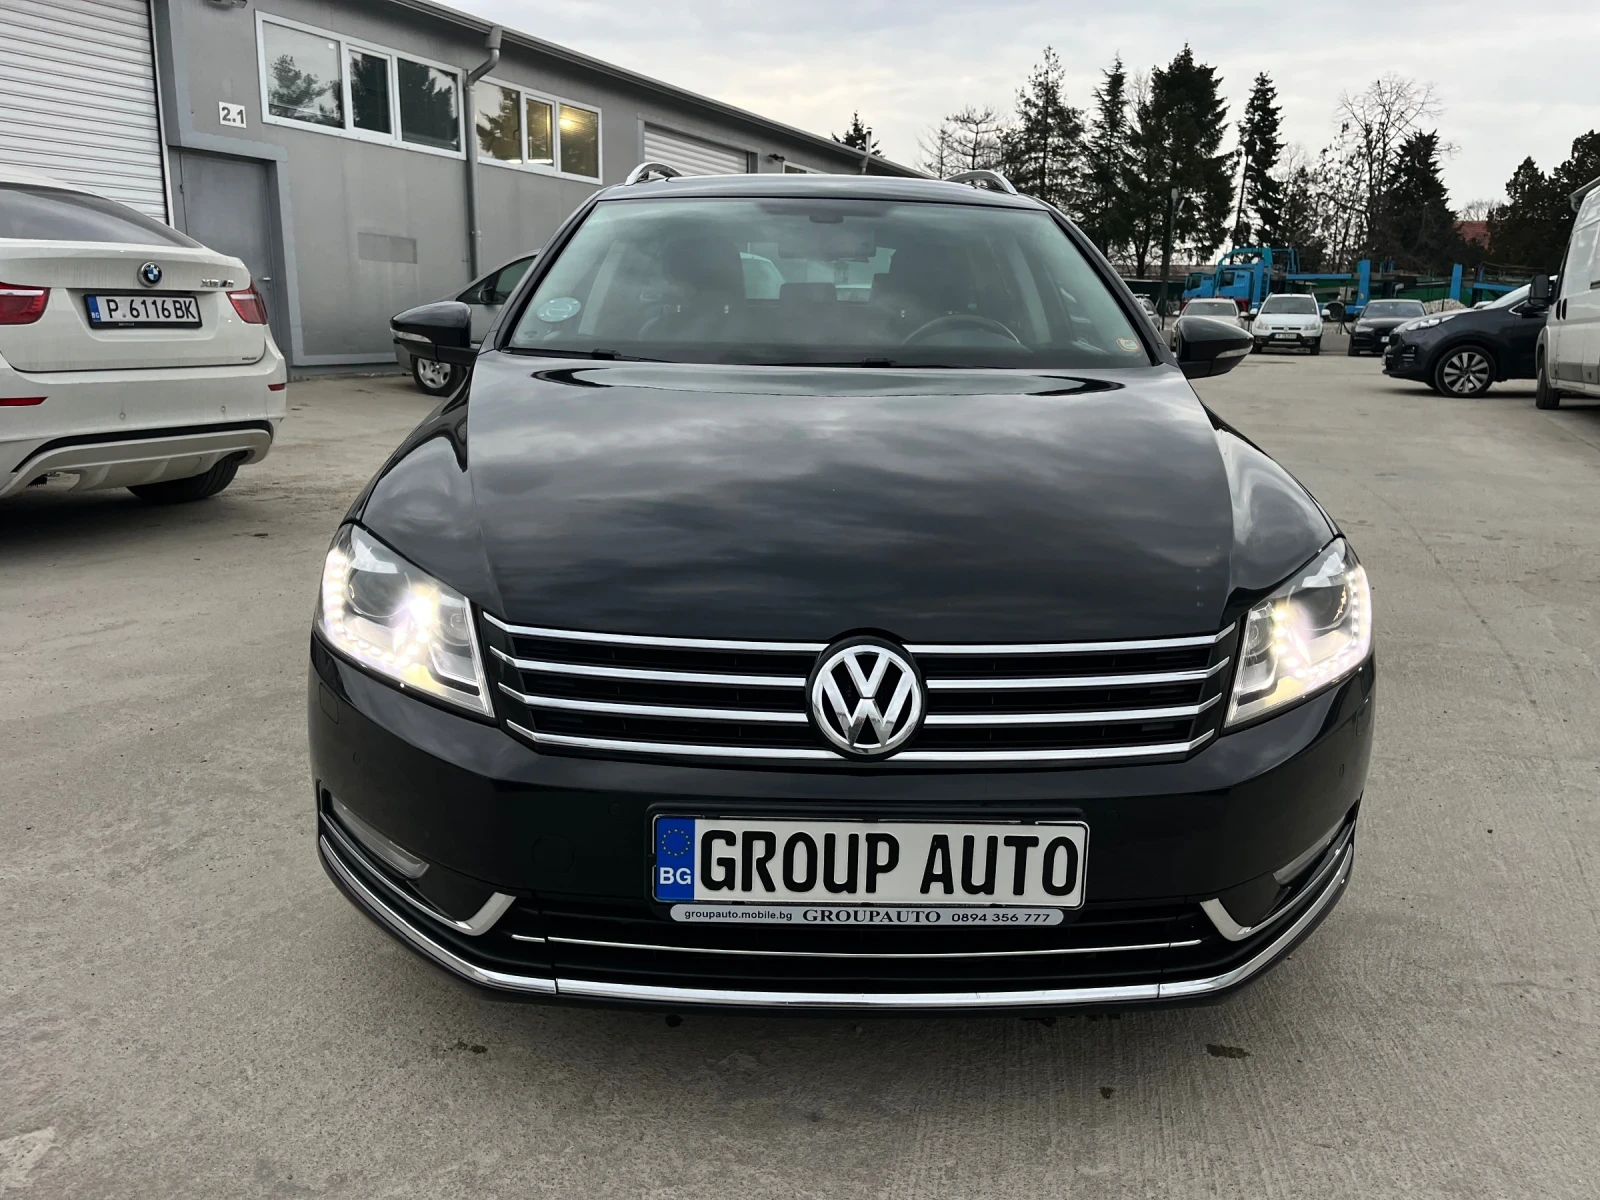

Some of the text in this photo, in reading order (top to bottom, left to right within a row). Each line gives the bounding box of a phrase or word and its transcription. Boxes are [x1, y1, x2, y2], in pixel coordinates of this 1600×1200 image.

[221, 106, 245, 125] 2.1
[91, 311, 100, 319] BG
[815, 647, 921, 752] VW
[700, 829, 1079, 897] GROUP AUTO
[659, 867, 692, 885] BG
[684, 909, 793, 921] groupauto.mobile.bg
[802, 909, 942, 923] GROUPAUTO
[951, 913, 1051, 923] 0894 356 777
